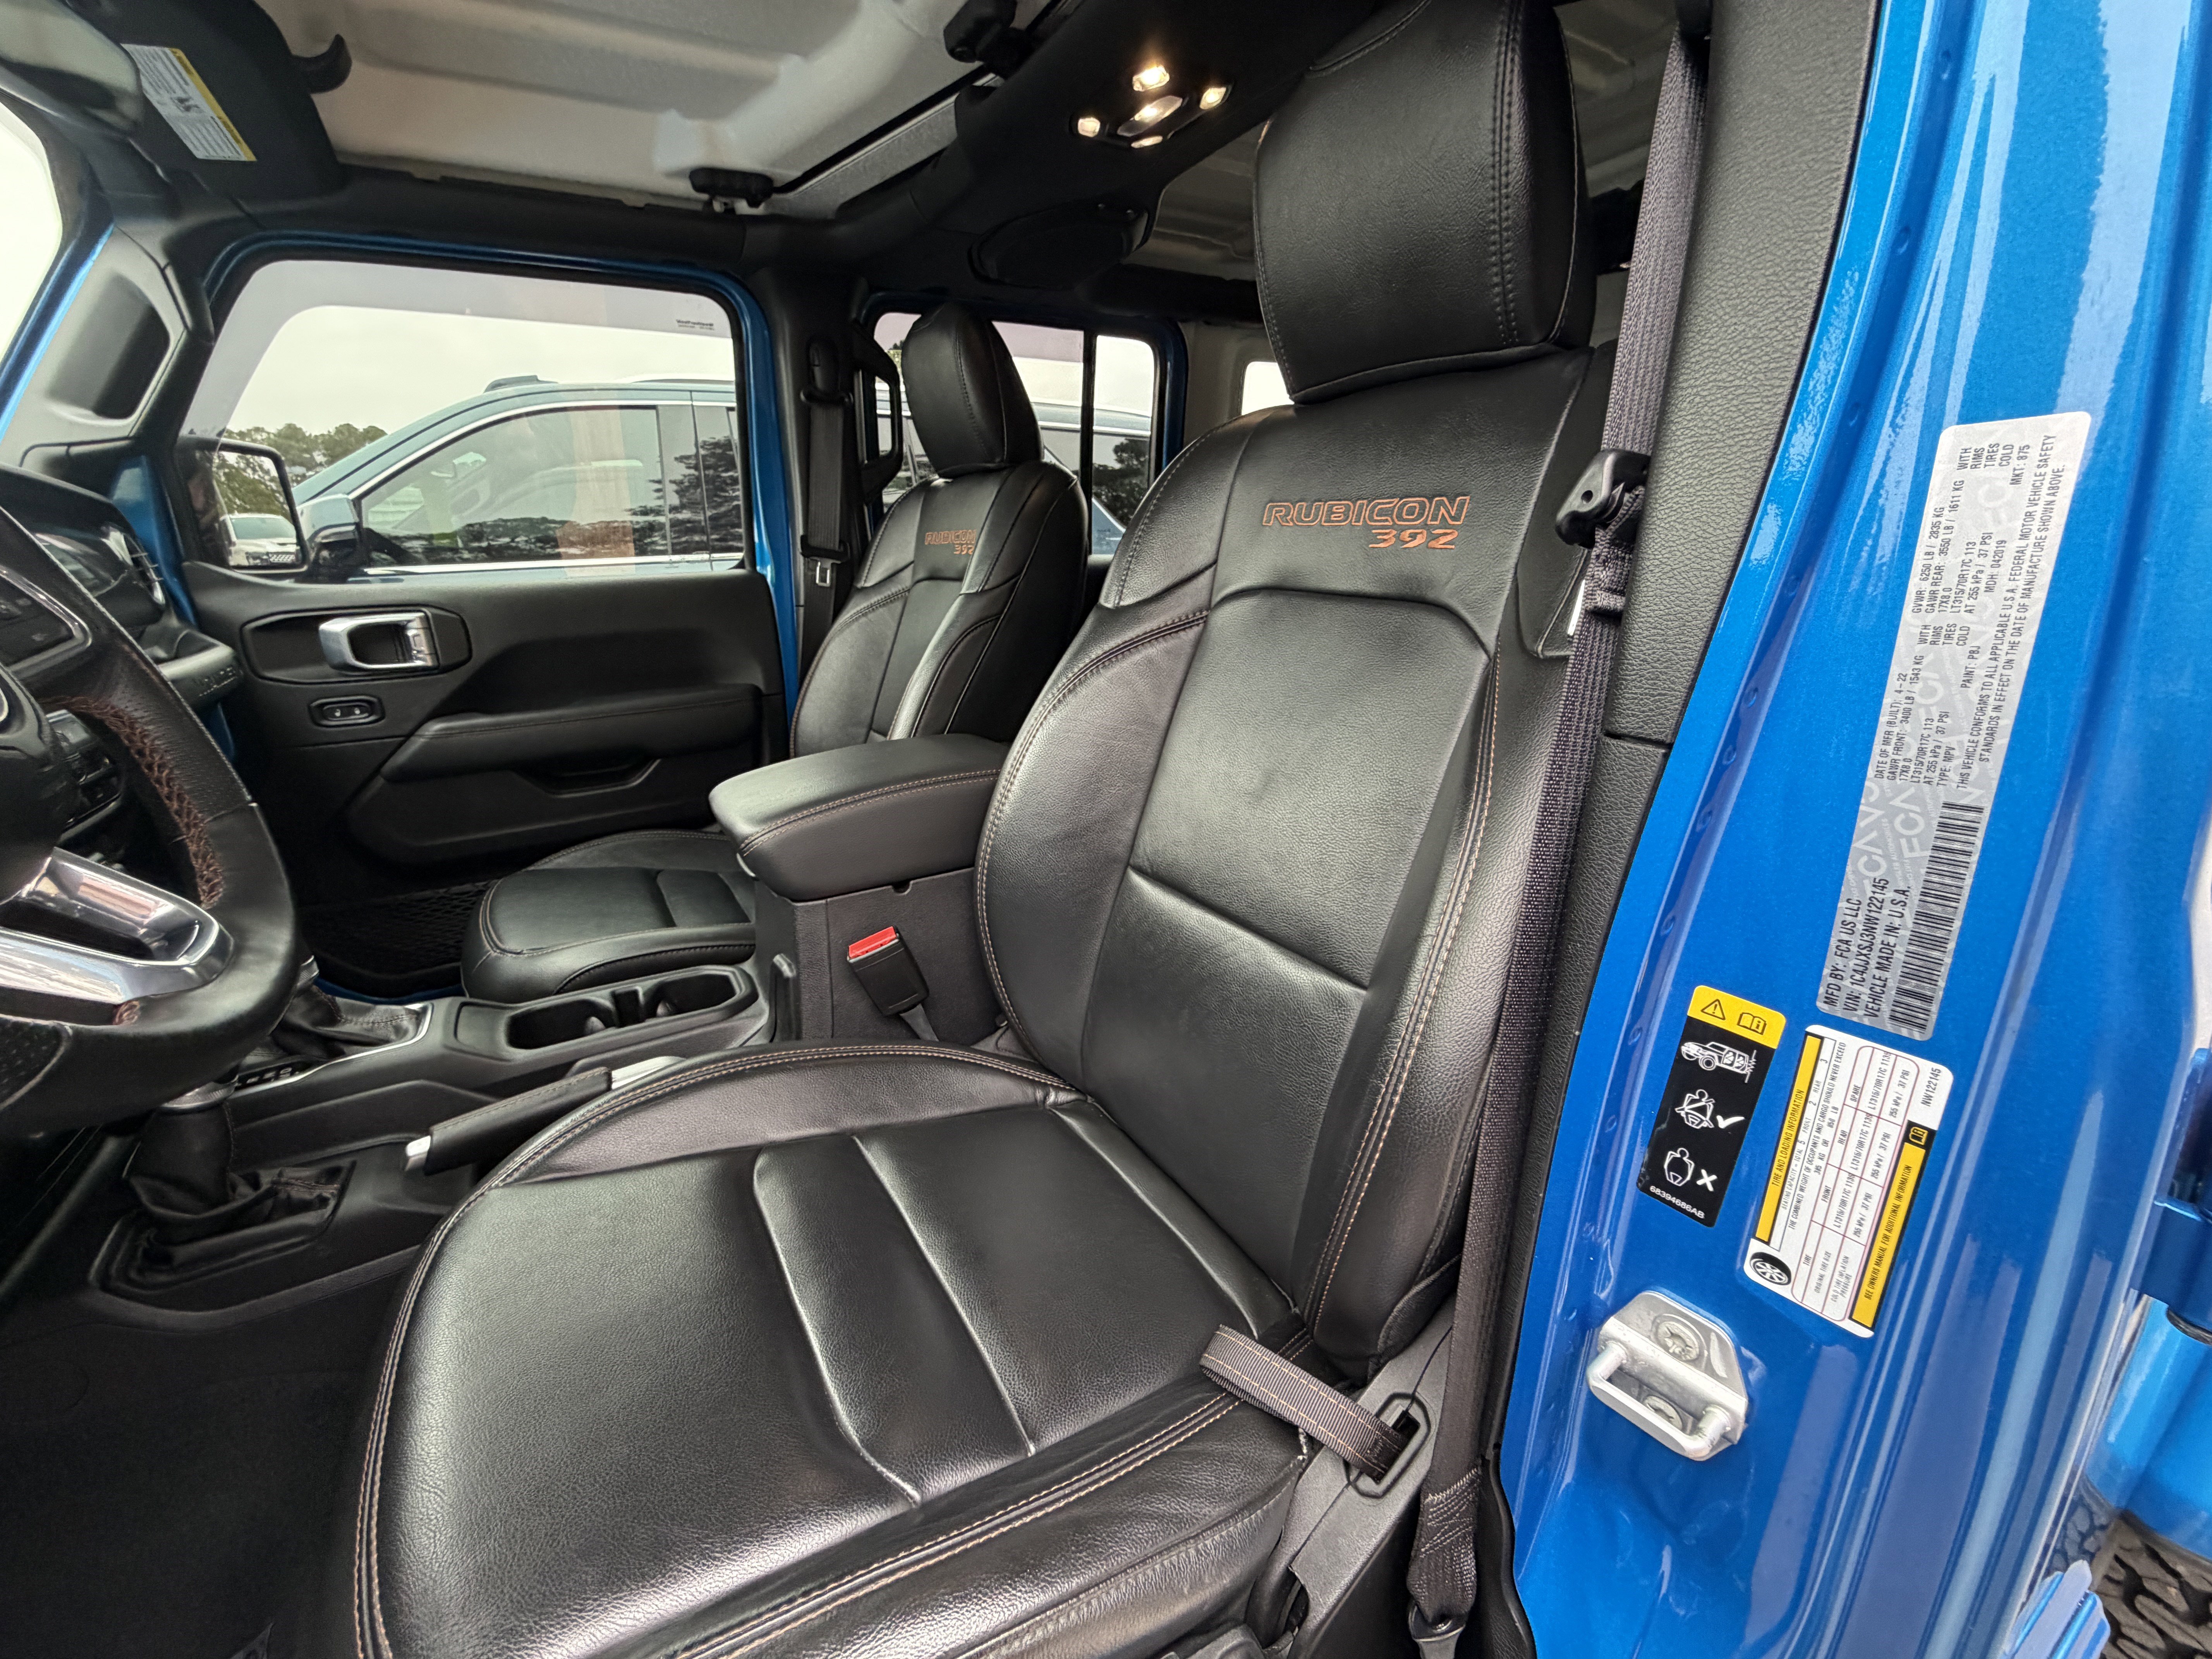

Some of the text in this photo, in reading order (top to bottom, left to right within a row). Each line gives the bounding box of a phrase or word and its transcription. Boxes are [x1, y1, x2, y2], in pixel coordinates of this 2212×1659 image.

[1956, 447, 1972, 470] WITH
[1969, 447, 1985, 469] RIMS
[1983, 442, 2000, 468] TIRES
[1998, 443, 2015, 467] COLD
[2009, 443, 2031, 486] MKT: 875
[1262, 496, 1470, 526] RUBICON
[925, 530, 976, 545] RUBICON
[1369, 529, 1458, 549] 392
[1924, 479, 1965, 613] GAWR REAR: 3550 LB 1611 KG
[1911, 506, 1946, 613] GVWR: 6250 LB 2835 KG
[1949, 541, 1977, 613] LT315/70R17C 113
[1963, 531, 1994, 614] AT 255 kPa 37 PSI
[1984, 539, 2007, 592] MDH: 042019
[1937, 587, 1953, 613] 17X8.0
[1956, 433, 2057, 790] THIS VEHICLE CONFORMS TO ALL APPLICABLE U.S.A. FEDERAL MOTOR VEHICLE SAFETY
[1978, 464, 2066, 763] STANDARDS IN EFFECT ON THE DATE OF MANUFACTURE SHOWN ABOVE.
[1917, 624, 1932, 645] WITH
[1929, 625, 1944, 645] RIMS
[1942, 623, 1958, 646] TIRES
[1956, 625, 1971, 646] COLD
[1967, 644, 1982, 660] PBJ
[1874, 672, 1908, 779] DATE OF MFR (BUILT): 4-22
[1886, 654, 1925, 781] GAWR FRONT: 3400 LB 1543 KG
[1910, 717, 1936, 784] LT315/70R17C 113
[1923, 710, 1950, 785] AT 255 kPa 37 PSI
[1936, 745, 1956, 787] TYPE: MPV
[1898, 757, 1913, 782] 17X8.0
[1822, 896, 1862, 1008] MFD BY: FCA US LLC
[1843, 876, 1890, 1013] VIN: 1C4JJXSJ3NW122145
[1863, 882, 1911, 1020] VEHICLE MADE IN: U.S.A.
[1849, 1083, 1862, 1103] SPARE
[1920, 1066, 1942, 1107] NW122145
[1771, 1088, 1805, 1187] TIRE AND LOADING INFORMATION
[1788, 1041, 1846, 1230] THE COMBINED WEIGHT OF OCCUPANTS AND CARGO SHOULD NEVER EXCEED
[1837, 1129, 1848, 1145] REAR
[1650, 1186, 1705, 1219] 68394686AB
[1820, 1184, 1832, 1203] FRONT
